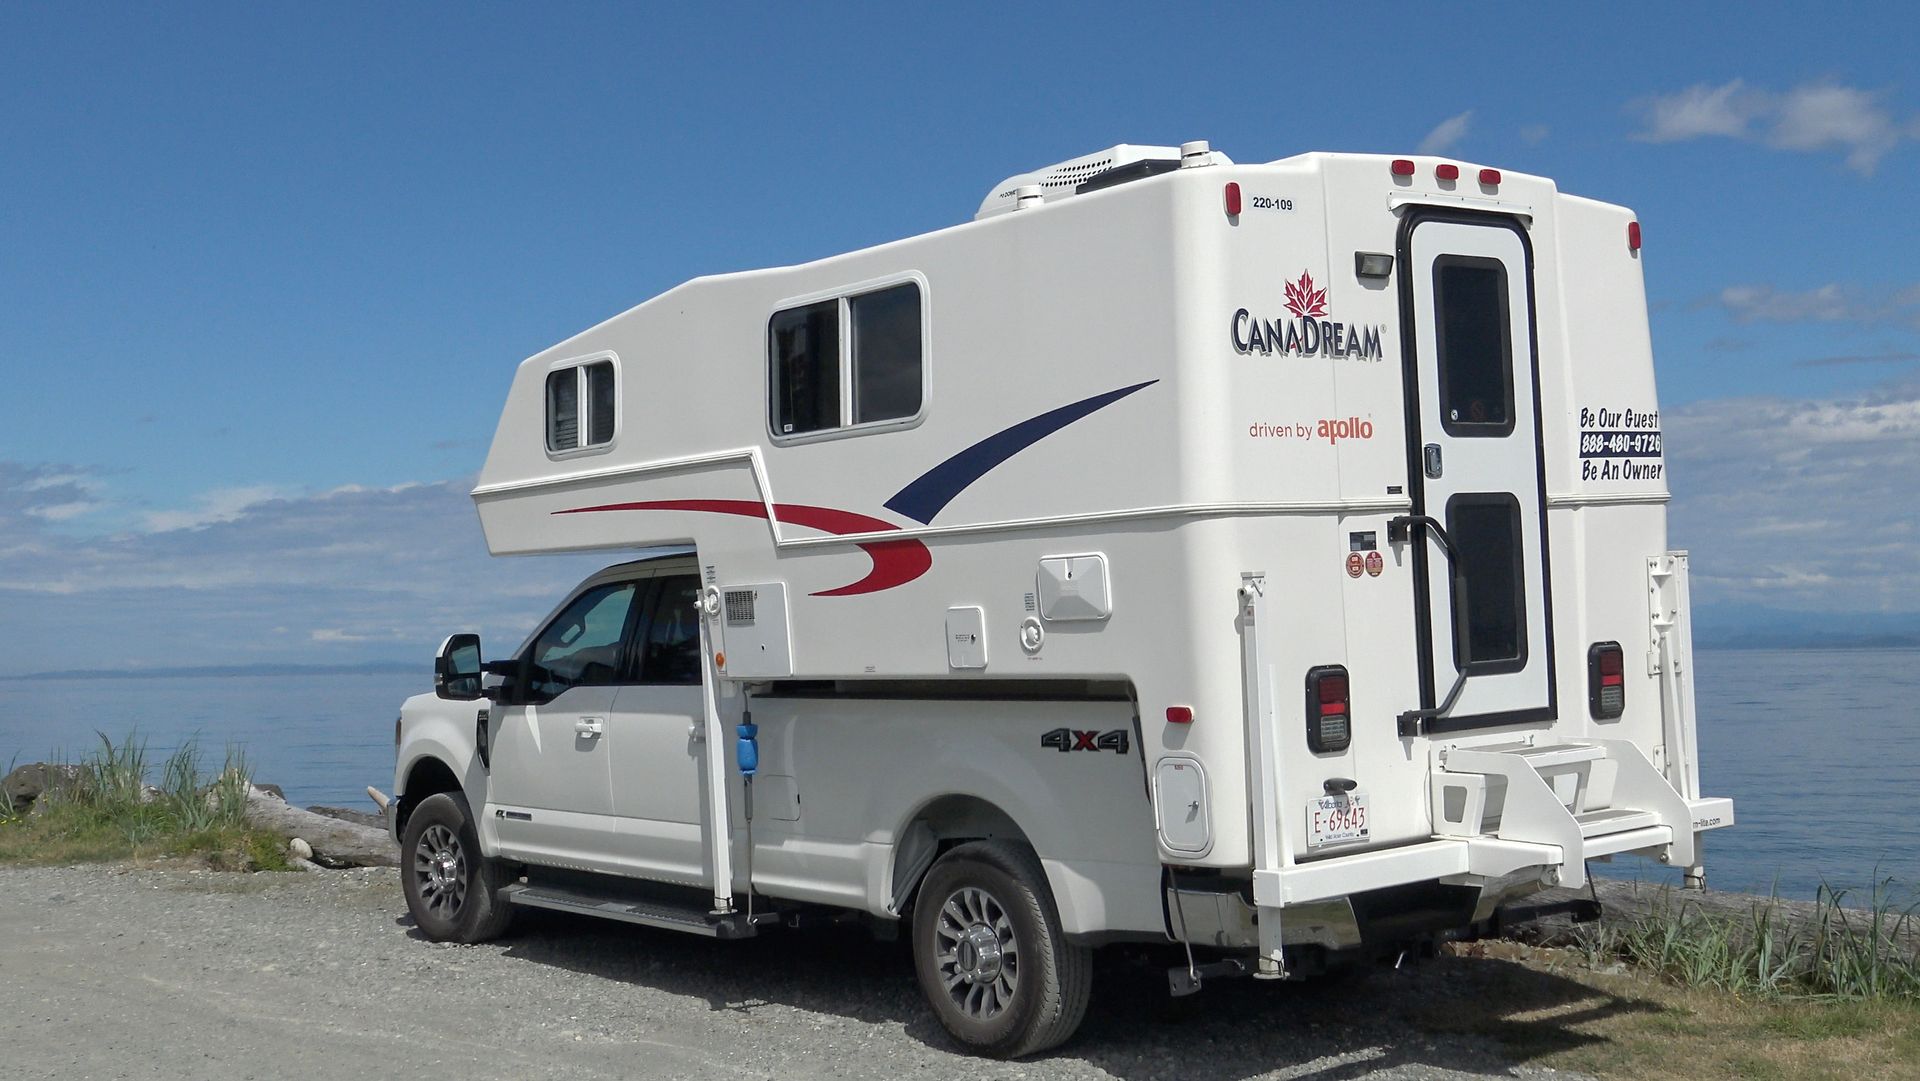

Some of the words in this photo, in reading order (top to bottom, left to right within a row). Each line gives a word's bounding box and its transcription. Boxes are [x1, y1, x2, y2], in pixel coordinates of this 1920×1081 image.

[1253, 197, 1292, 210] 220-109
[1580, 407, 1595, 428] Be
[1599, 408, 1622, 428] Our
[1625, 408, 1658, 428] Guest
[1249, 423, 1292, 438] driven
[1296, 423, 1312, 441] by
[1317, 417, 1373, 445] apollo
[1581, 434, 1661, 453] 888-480-9726
[1582, 459, 1597, 481] Be
[1601, 459, 1619, 480] An
[1623, 459, 1663, 480] Owner
[1314, 807, 1365, 833] E-69643
